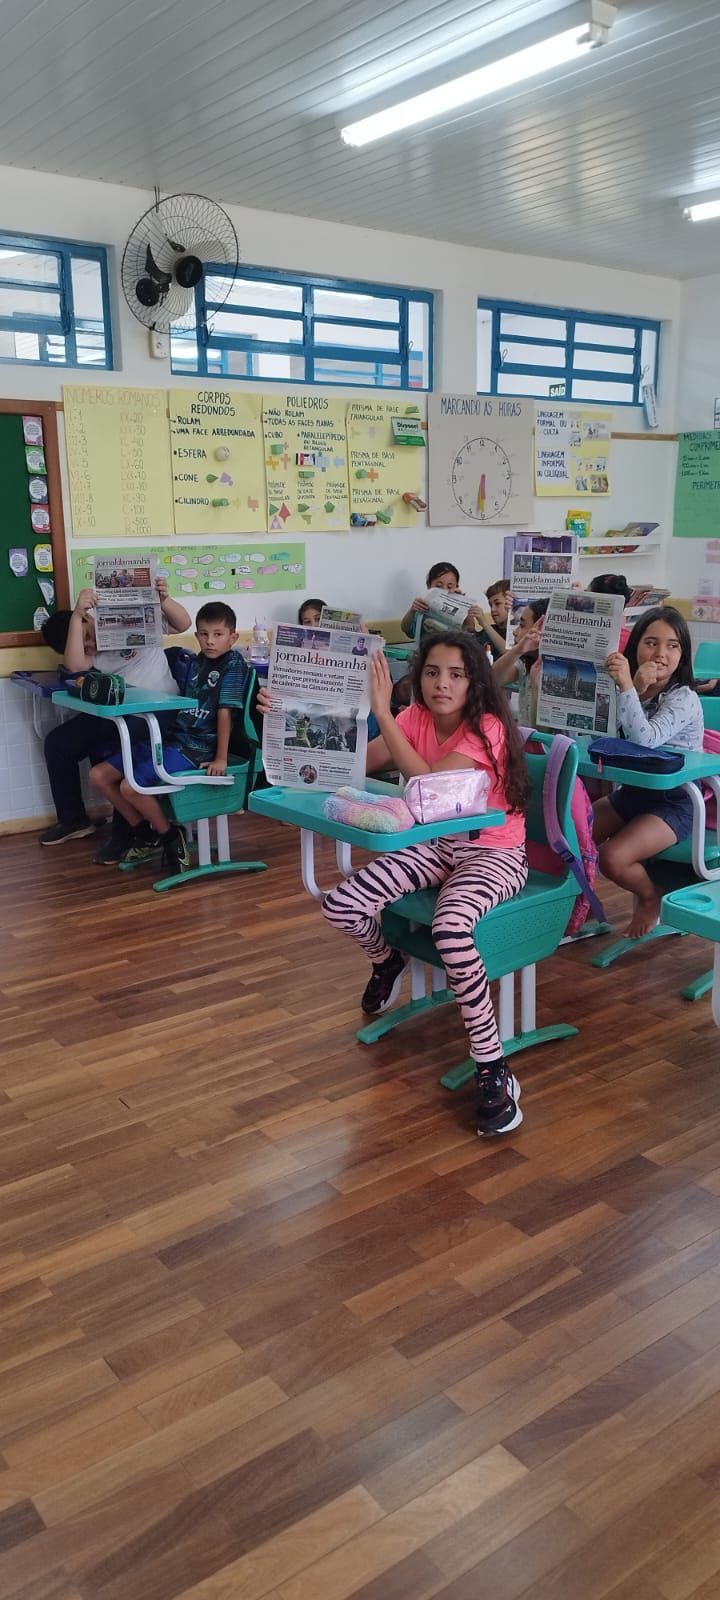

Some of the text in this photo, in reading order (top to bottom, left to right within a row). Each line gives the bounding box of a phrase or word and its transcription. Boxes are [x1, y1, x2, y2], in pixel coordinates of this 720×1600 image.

[550, 384, 566, 397] SAÍD
[198, 392, 231, 406] CORPOS
[286, 396, 329, 410] POLIEDROS
[191, 404, 236, 416] REDONDOS
[352, 404, 372, 412] PRISMA
[441, 398, 522, 416] MARCANDO AS HORAS
[268, 408, 281, 416] NÃO
[177, 416, 200, 425] ROLAM
[350, 413, 383, 421] TRIANGULAR
[268, 418, 286, 426] TODAS
[212, 428, 255, 438] ARREDONDADA
[178, 448, 207, 458] ESFERA
[178, 474, 199, 482] CONE
[544, 470, 569, 479] COLOQUIAL
[502, 489, 506, 497] 4
[178, 497, 209, 505] CILINDRO
[494, 502, 499, 511] 5
[546, 612, 612, 628] jornaldamanhã
[276, 648, 367, 671] jornaldamanhã
[273, 666, 303, 675] Vereadores
